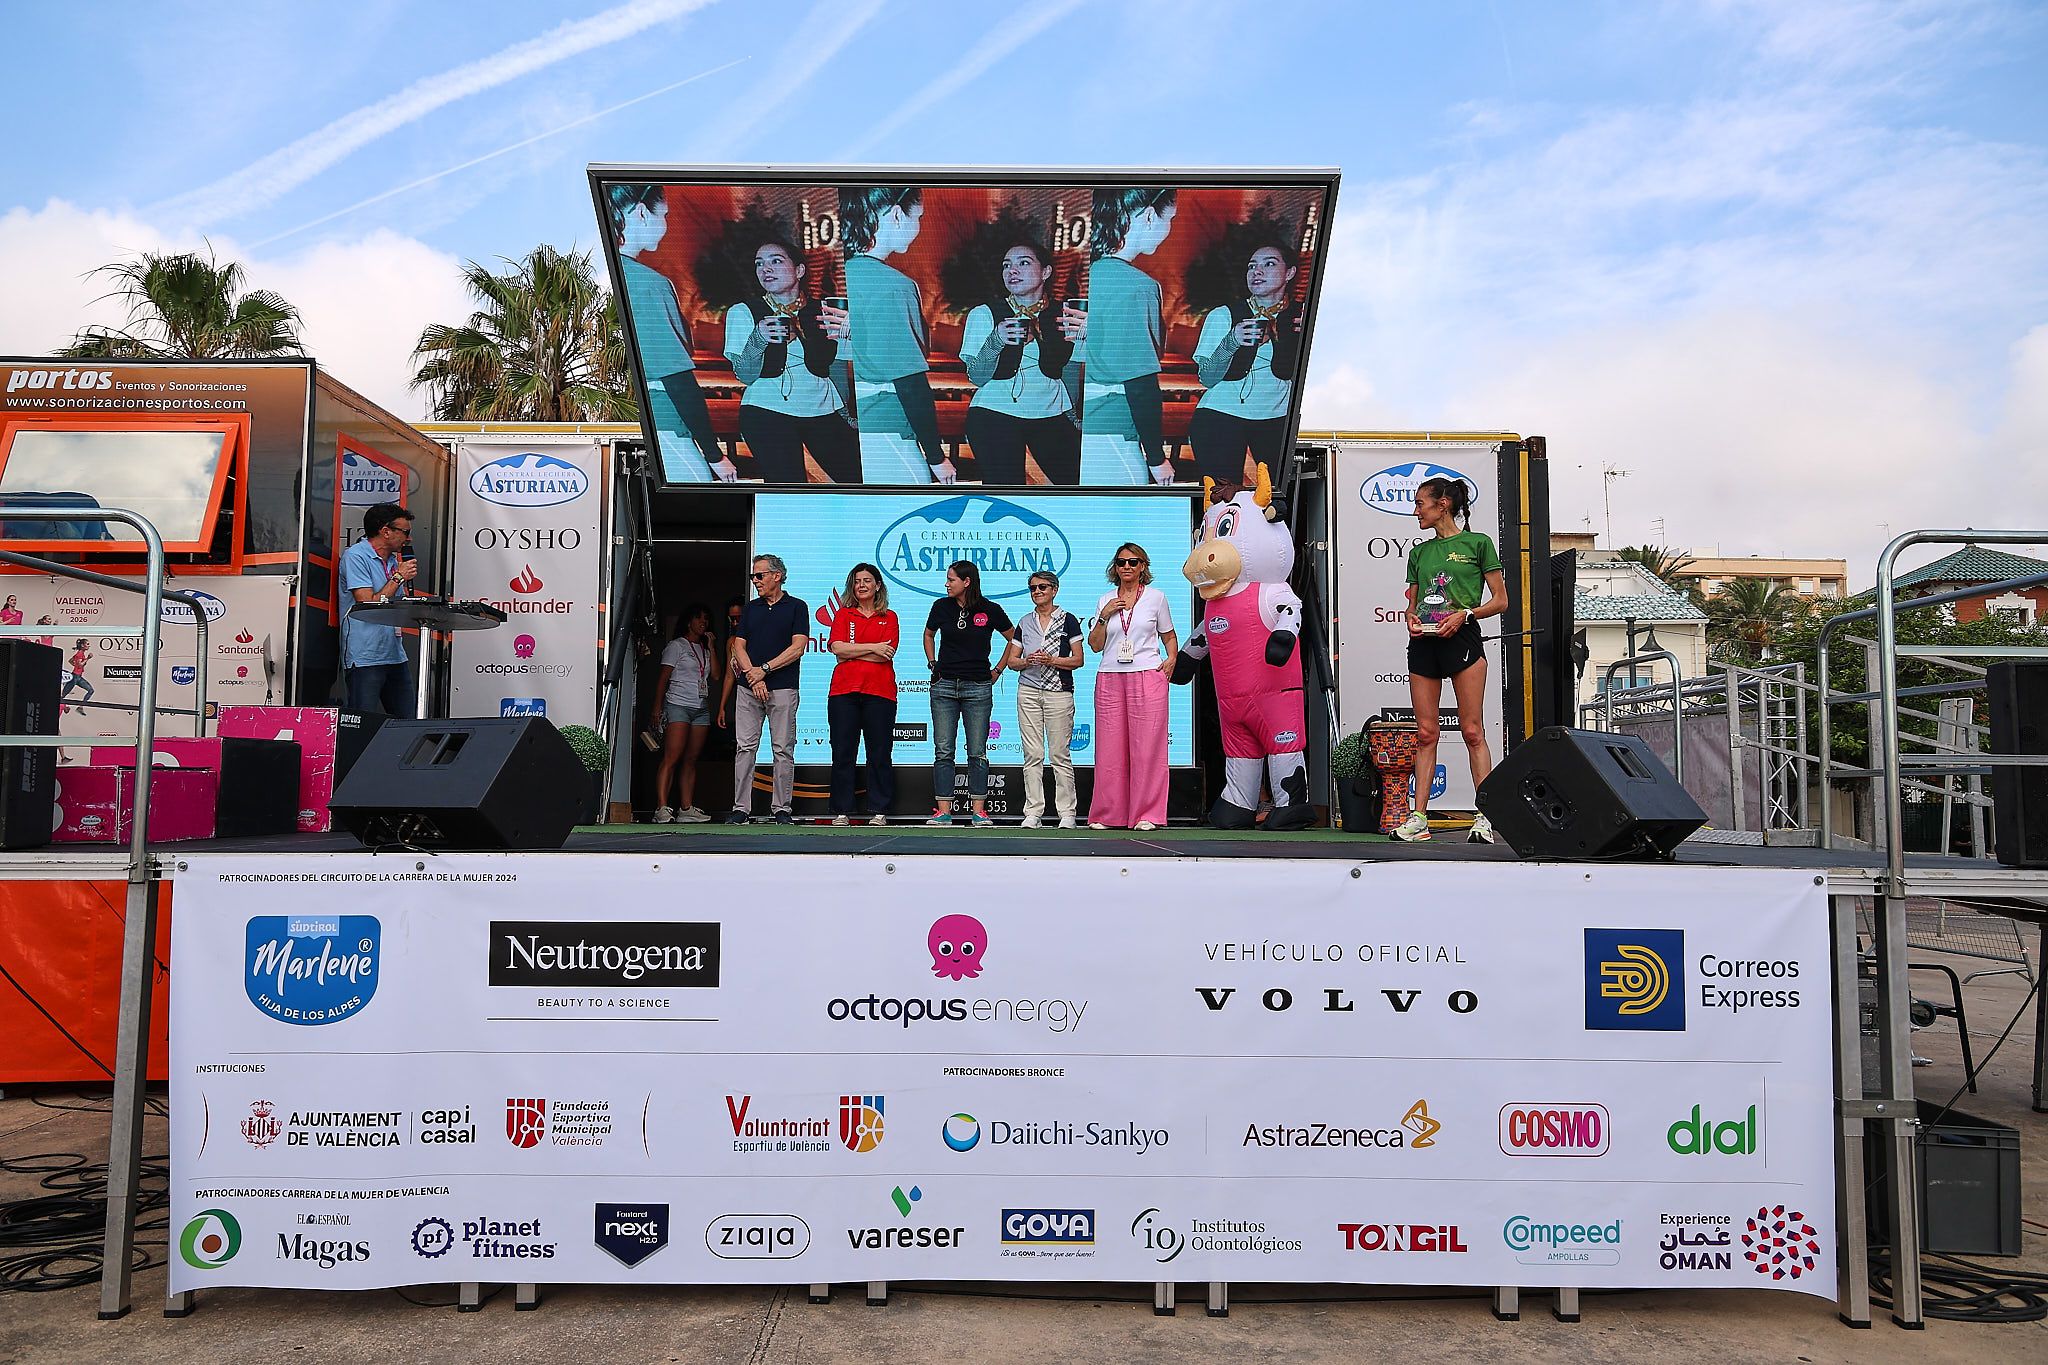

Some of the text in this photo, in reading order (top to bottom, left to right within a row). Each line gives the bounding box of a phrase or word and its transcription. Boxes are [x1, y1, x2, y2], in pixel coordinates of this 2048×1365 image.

[6, 368, 247, 393] portos Eventos y Sonorizaciones
[6, 396, 247, 411] www.sonorizacionesportos.com
[477, 472, 580, 494] ASTURIANA
[474, 527, 581, 550] OYSHO
[921, 531, 1050, 541] CENTRAL LECHERA
[890, 532, 1056, 572] ASTURIANA
[55, 597, 104, 605] VALENCIA
[479, 597, 574, 614] antander
[218, 644, 264, 655] Santande
[107, 667, 142, 678] Neutrogen
[475, 663, 573, 678] octopus energy
[1374, 672, 1409, 686] octop
[892, 727, 924, 740] trogena
[219, 873, 517, 882] PATROCINADORES DEL CIRCUITO DE LA CARRERA DE LA MUJER 2024
[504, 935, 704, 980] Neutrogena
[1204, 939, 1466, 963] VEHÍCULO OFICIAL
[253, 938, 373, 996] Marlene
[1699, 954, 1800, 978] Correos
[257, 992, 361, 1021] HIJA DE LOS ALPES
[537, 998, 671, 1008] BEAUTY TO A SCIENCE
[1195, 986, 1479, 1014] VOLVO
[1701, 984, 1801, 1013] Express
[827, 993, 1088, 1032] octopus energy
[195, 1064, 266, 1073] INSTITUCIONES
[943, 1067, 1065, 1077] PATROCINADORES BRONCE
[552, 1100, 609, 1111] Fundació
[289, 1111, 402, 1127] AJUNTAMENT
[552, 1112, 611, 1124] Esportiva
[725, 1095, 830, 1137] Voluntariat
[420, 1124, 476, 1144] casal
[551, 1124, 612, 1136] Municipal
[990, 1120, 1169, 1155] Daiichi-Sankyo
[1242, 1123, 1404, 1148] AstraZeneca
[1508, 1109, 1601, 1148] COSMO
[1667, 1103, 1756, 1155] dial
[287, 1129, 401, 1147] DE VALÈNCIA
[551, 1135, 603, 1147] València
[733, 1140, 830, 1153] Esportiu de València
[195, 1186, 450, 1199] PATROCINADORES CARRERA DE LA MUJER DE VALENCIA
[297, 1212, 352, 1226] EL ESPAÑOL
[605, 1220, 658, 1236] next
[1006, 1213, 1090, 1239] GOYA
[1191, 1218, 1265, 1234] Institutos
[1660, 1213, 1731, 1227] Experience
[462, 1216, 541, 1242] planet
[847, 1226, 965, 1249] vareser
[1503, 1215, 1621, 1252] Compeed
[421, 1229, 444, 1249] pf
[720, 1227, 795, 1254] ziaja
[1191, 1236, 1303, 1254] Odontológicos
[276, 1232, 371, 1270] Magas
[472, 1238, 555, 1259] fitness
[1547, 1252, 1589, 1261] AMPOLLAS
[1660, 1252, 1732, 1271] OMAN
